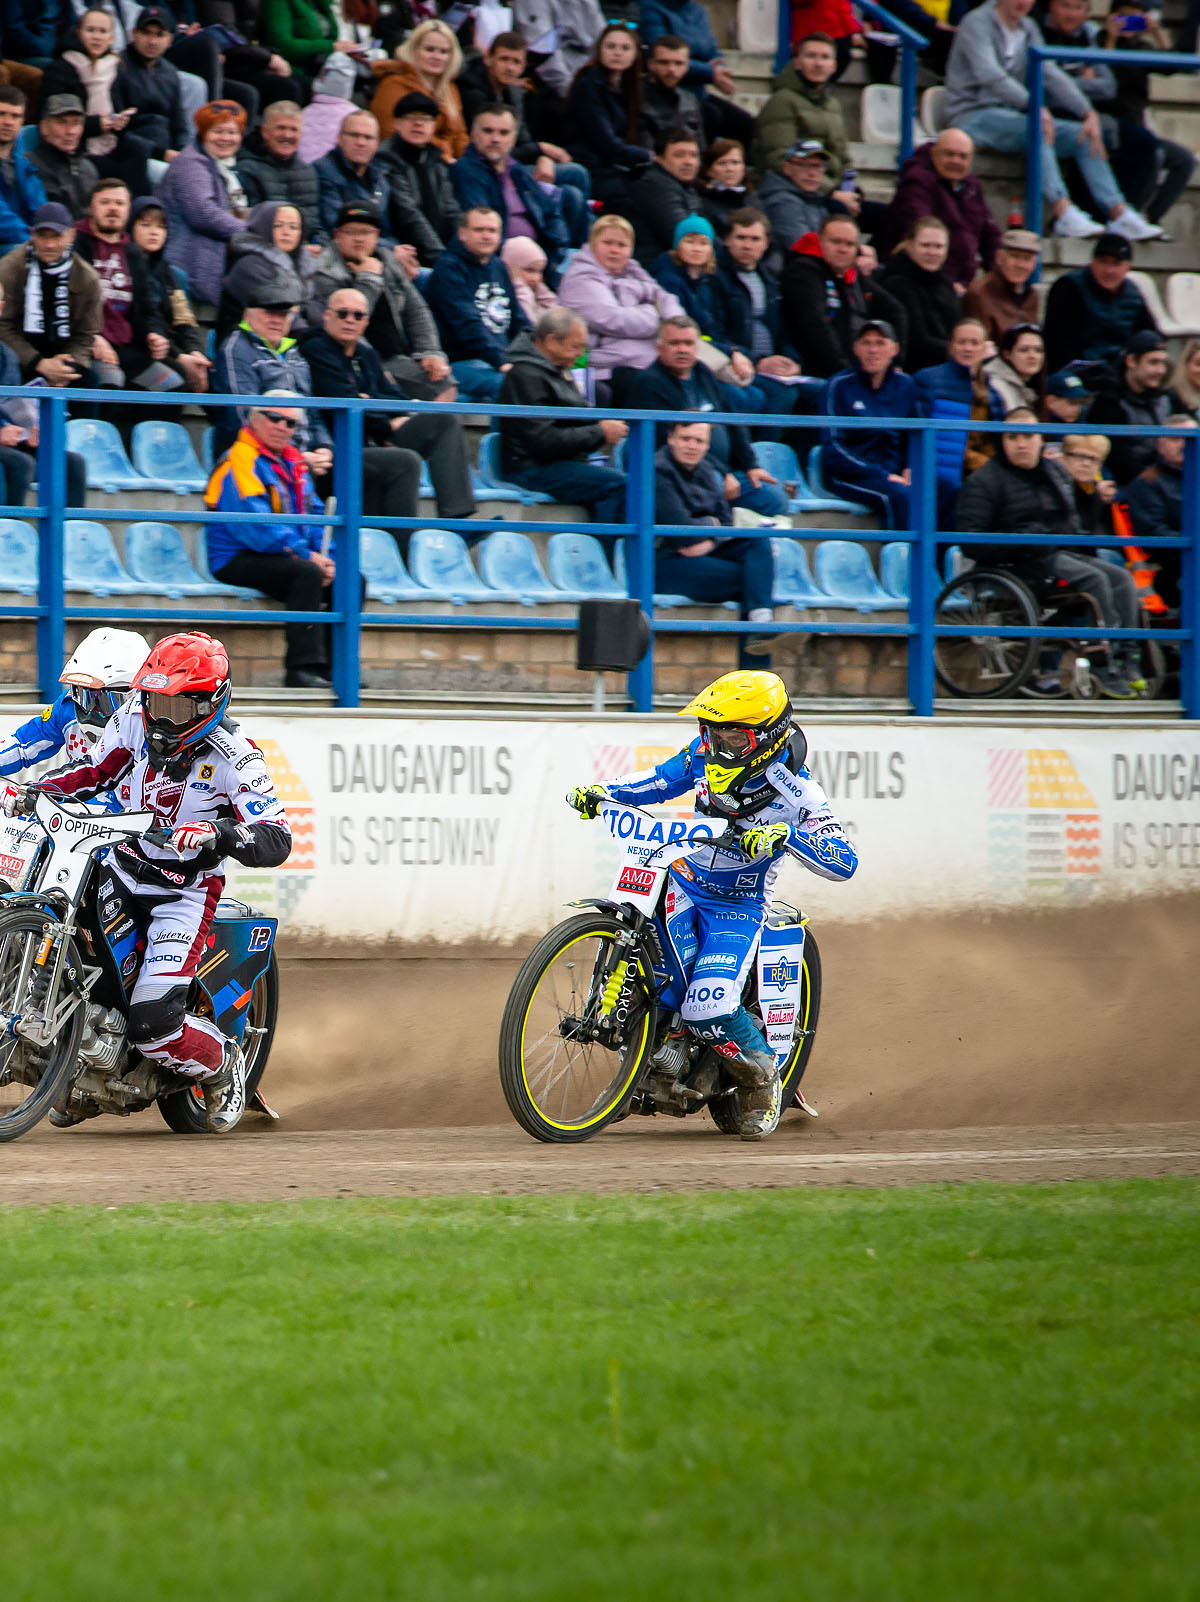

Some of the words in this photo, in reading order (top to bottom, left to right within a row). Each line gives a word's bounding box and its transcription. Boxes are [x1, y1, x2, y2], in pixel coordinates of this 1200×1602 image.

[210, 728, 238, 758] Interio
[329, 743, 512, 795] DAUGAVPILS
[64, 819, 115, 840] OPTIBET
[330, 816, 355, 865] IS
[365, 816, 500, 866] SPEEDWAY
[1112, 822, 1137, 869] IS
[621, 869, 655, 886] AMD
[619, 882, 650, 892] GROUP
[152, 929, 193, 942] Interio
[247, 926, 272, 952] 12
[771, 967, 793, 982] REALL
[686, 986, 726, 1004] HOG
[688, 1003, 718, 1013] POLSKA
[766, 1009, 795, 1024] BauLand
